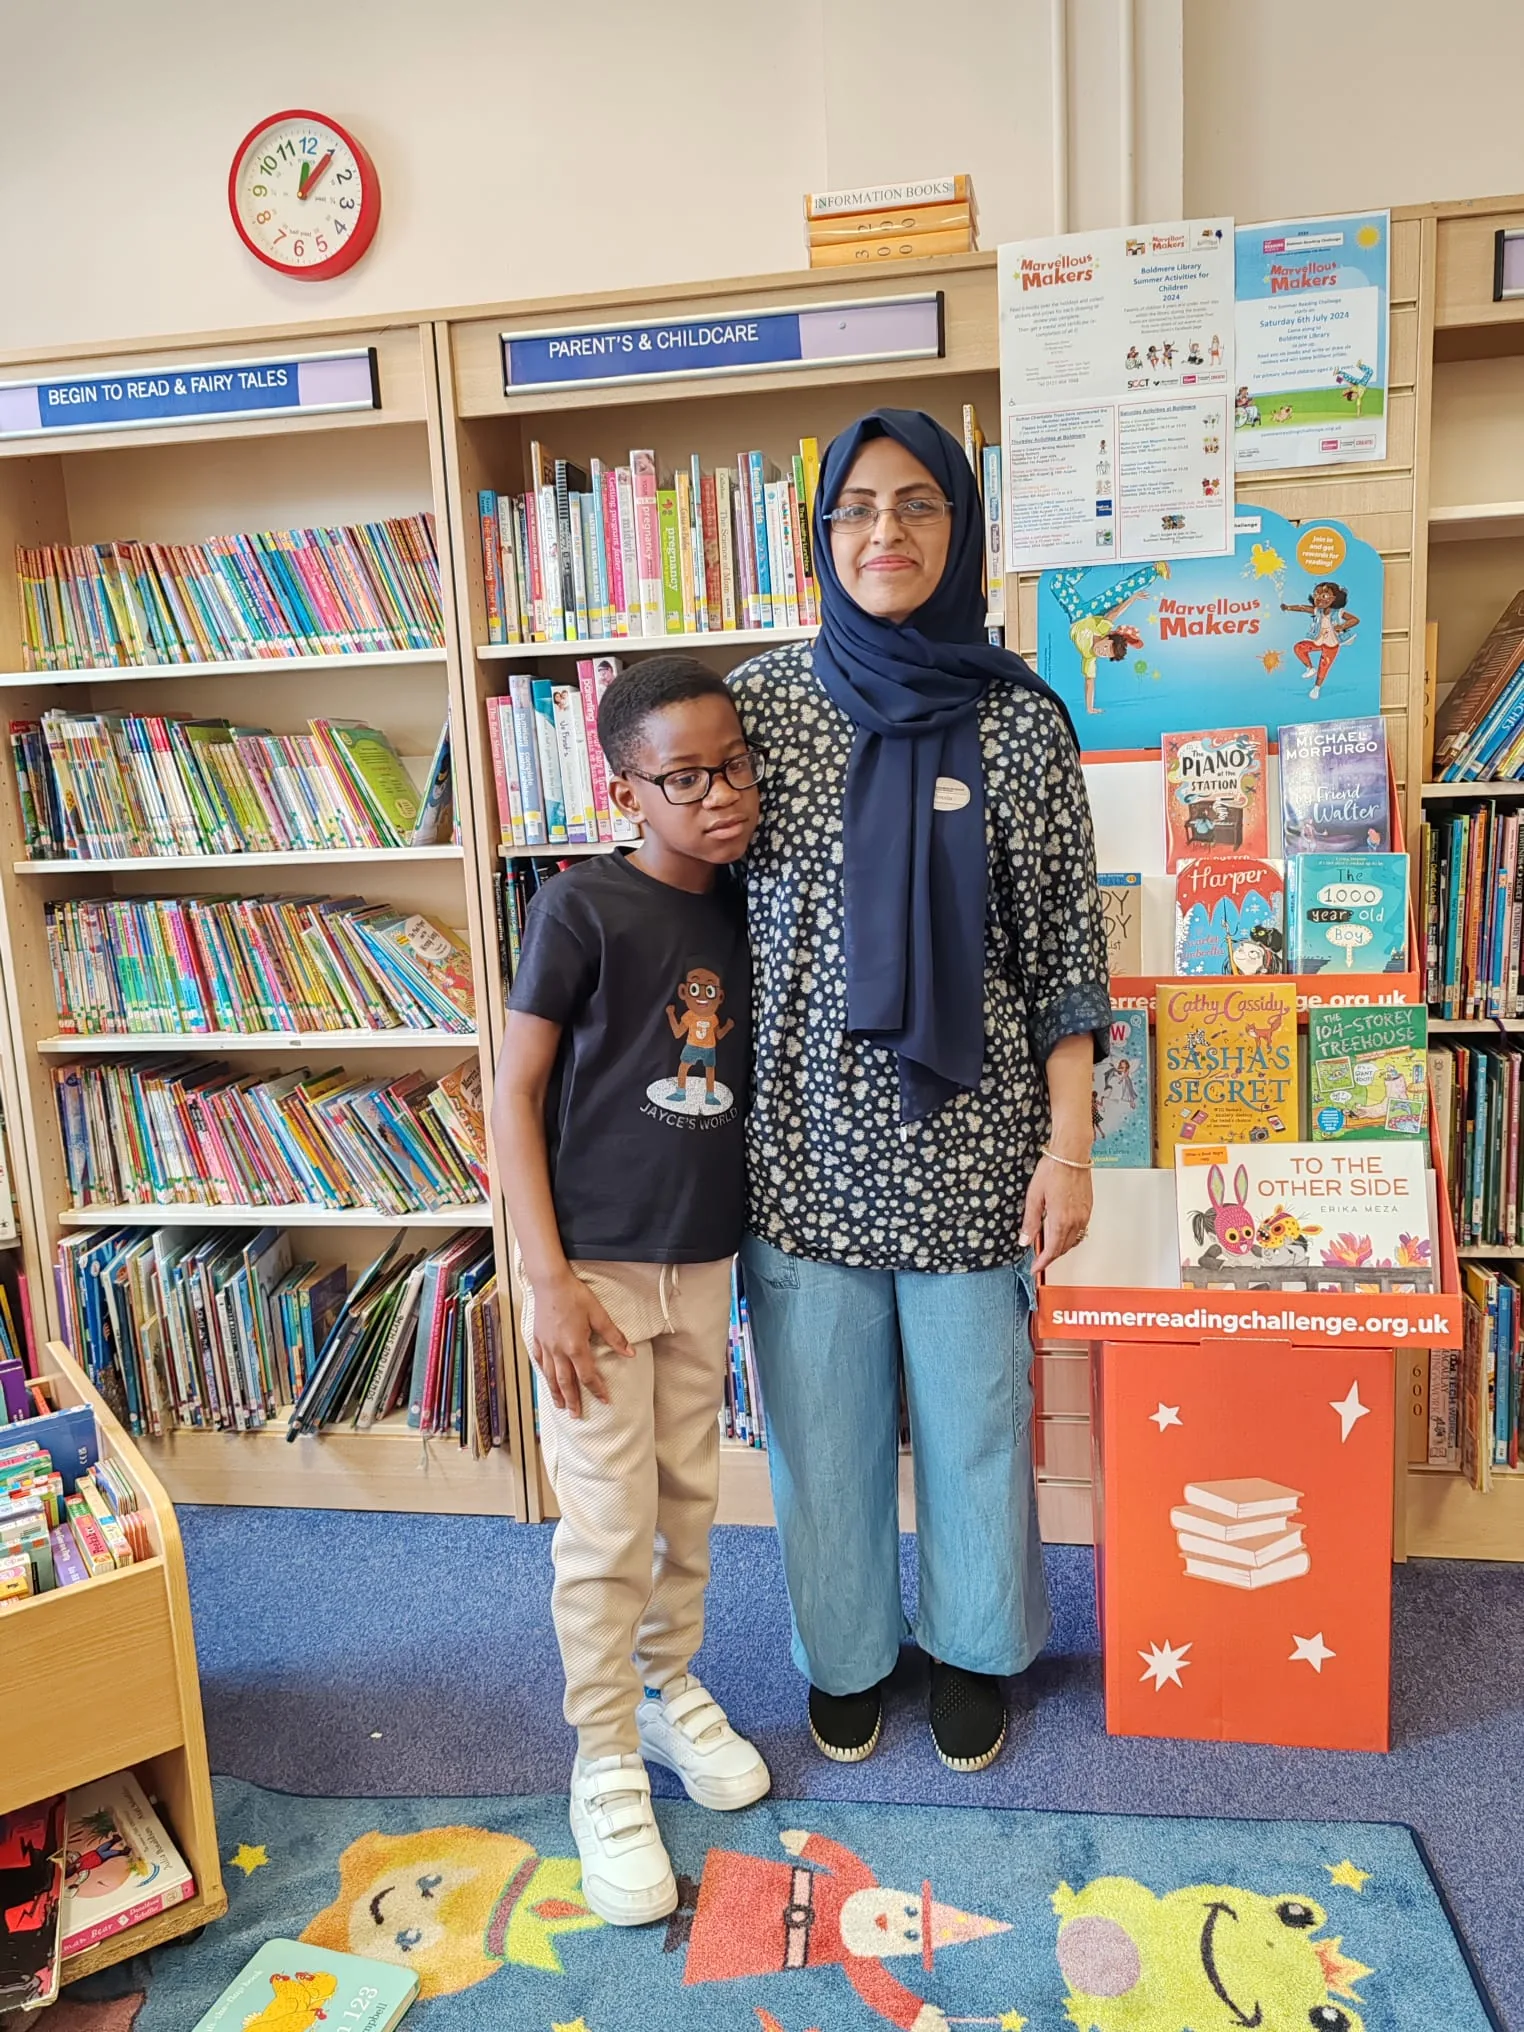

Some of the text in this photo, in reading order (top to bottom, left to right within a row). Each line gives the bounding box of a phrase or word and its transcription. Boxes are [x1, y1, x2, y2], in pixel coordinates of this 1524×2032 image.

[276, 139, 296, 161] 11
[298, 136, 318, 155] 12
[259, 155, 278, 176] 10
[336, 168, 353, 185] 2
[252, 184, 268, 198] 9
[815, 182, 949, 209] INFORMATION BOOKS
[339, 196, 355, 210] 3
[256, 210, 272, 225] 8
[334, 218, 348, 236] 4
[273, 228, 288, 245] 7
[315, 234, 328, 252] 5
[1152, 241, 1184, 251] Makers
[293, 239, 304, 257] 6
[1021, 253, 1093, 272] Marvellous
[1141, 263, 1201, 274] Boldmere Library
[1270, 261, 1337, 275] Marvellous
[1022, 268, 1093, 291] Makers
[1133, 277, 1162, 285] Summer
[1164, 274, 1197, 282] Activities
[1159, 284, 1188, 292] Children
[1271, 274, 1337, 294] Makers
[1260, 318, 1295, 328] Saturday
[1312, 314, 1328, 323] July
[1330, 312, 1350, 320] 2024
[549, 325, 758, 358] PARENT'S & CHILDCARE
[1279, 334, 1307, 342] Boldmere
[48, 369, 288, 406] BEGIN TO READ & FAIRY TALES
[752, 466, 762, 502] feeding
[608, 477, 622, 572] Getting pregnant faster
[642, 506, 653, 559] pregnancy
[799, 520, 807, 541] Healthy
[622, 518, 633, 563] midwife
[666, 527, 679, 592] pregnancy
[722, 562, 729, 570] of
[802, 542, 810, 574] Lunchbox
[1305, 558, 1333, 568] reading!
[723, 573, 731, 593] Mom
[1158, 597, 1260, 615] Marvellous
[1160, 614, 1261, 641] Makers
[583, 678, 596, 723] parenting
[1296, 731, 1368, 748] MICHAEL
[1192, 750, 1204, 758] The
[1286, 742, 1378, 760] MORPURGO
[594, 750, 606, 773] baby's
[1182, 749, 1245, 777] PIANO
[598, 774, 608, 793] first
[1192, 779, 1238, 791] STATION
[1317, 784, 1360, 803] Friend
[1313, 799, 1380, 824] Walter
[1188, 866, 1267, 894] Harper
[1337, 868, 1364, 883] The
[1100, 889, 1130, 916] DY
[1311, 910, 1347, 922] year
[1103, 913, 1132, 939] DY
[1512, 906, 1521, 951] CHEMISTRY
[1336, 928, 1363, 944] Boy
[1168, 991, 1221, 1024] Cathy
[1223, 990, 1290, 1024] Cassidy
[1316, 1009, 1413, 1042] 104-STOREY
[1323, 1013, 1342, 1024] THE
[696, 1021, 710, 1039] J
[1318, 1027, 1416, 1057] TREEHOUSE
[1167, 1045, 1291, 1073] SASHA'S
[1164, 1079, 1291, 1110] SECRET
[639, 1102, 738, 1130] JAYCE'S WORLD
[1290, 1157, 1382, 1174] TO THE
[1258, 1179, 1409, 1197] OTHER SIDE
[1320, 1205, 1399, 1213] ERIKA MEZA
[1052, 1307, 1449, 1337] summerreadingchallenge.org.uk
[1431, 1349, 1440, 1414] HINGS WORK
[129, 1899, 160, 1916] Donaldson
